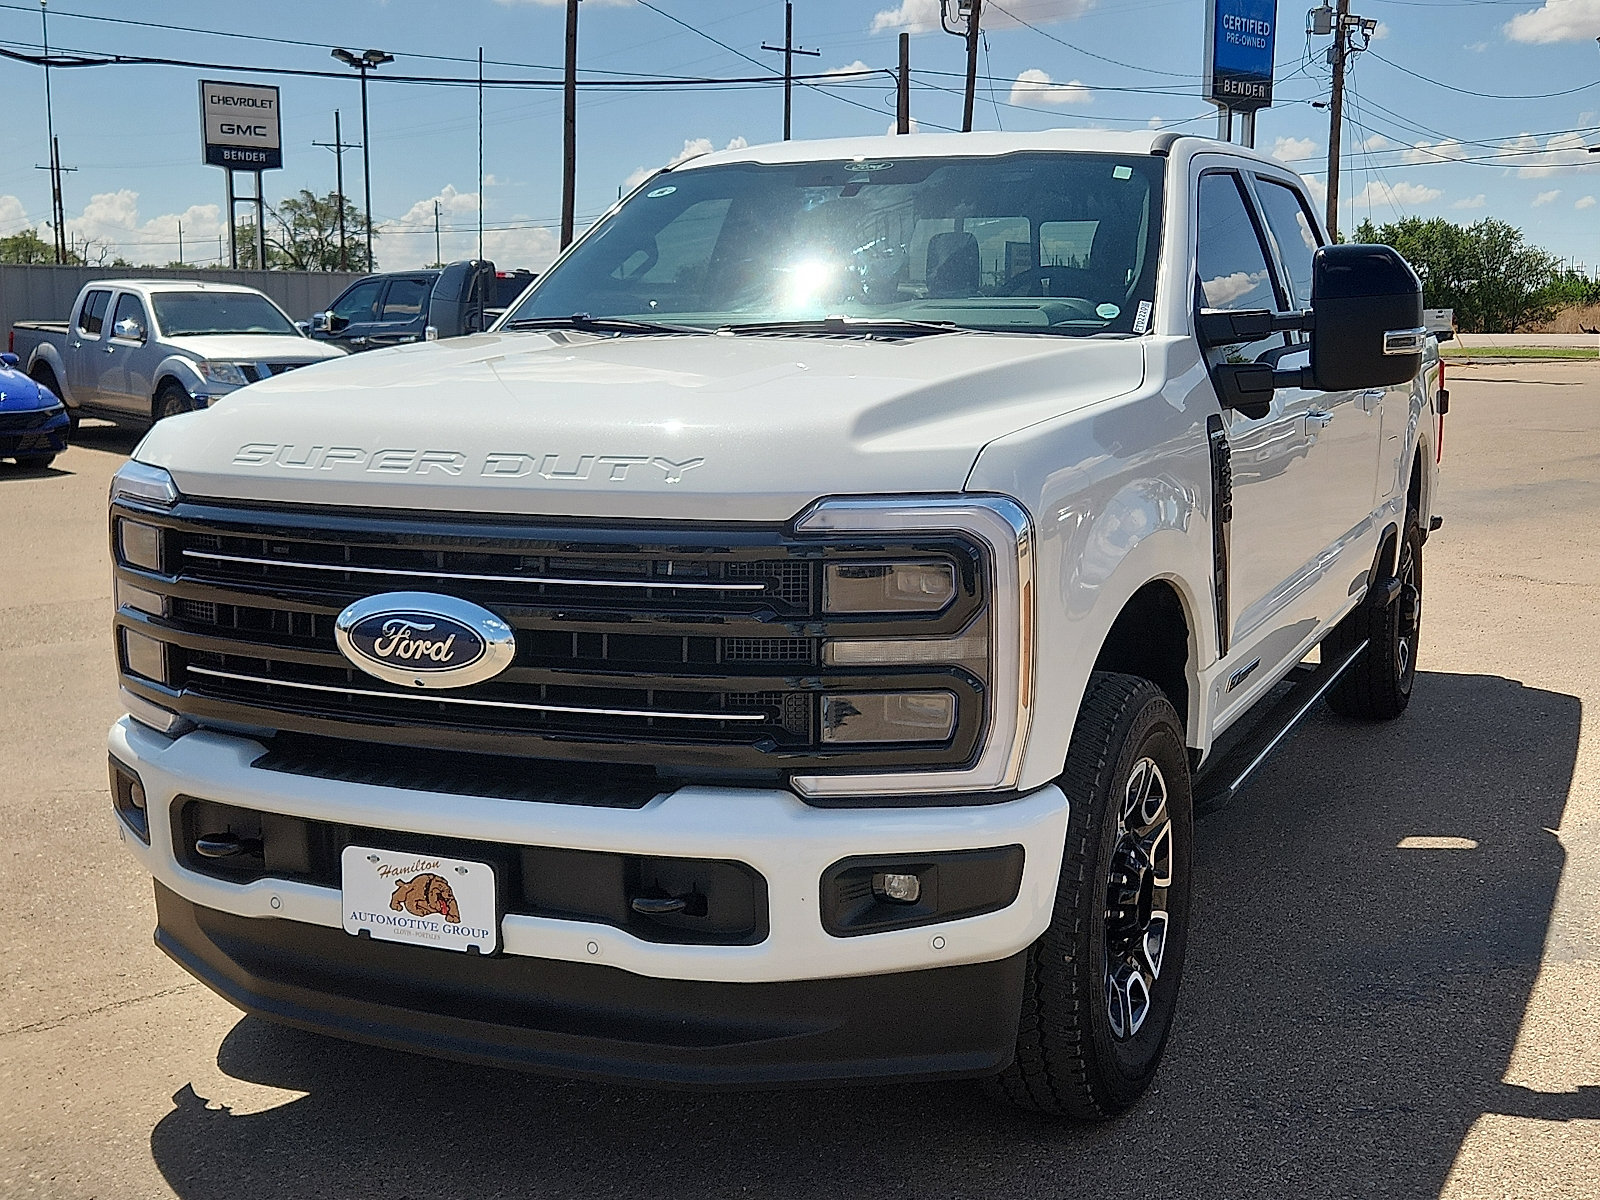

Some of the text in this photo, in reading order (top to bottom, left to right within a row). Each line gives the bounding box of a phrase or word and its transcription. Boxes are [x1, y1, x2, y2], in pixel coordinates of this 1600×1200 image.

[1223, 14, 1270, 36] CERTIFIED
[1226, 32, 1266, 48] PRE-OWNED
[1224, 80, 1265, 97] BENDER
[210, 95, 273, 108] CHEVROLET
[220, 123, 267, 136] GMC
[223, 150, 266, 162] BENDER
[232, 443, 706, 484] SUPER DUTY
[374, 618, 457, 663] Ford
[376, 859, 442, 879] Hamilton
[350, 911, 489, 938] AUTOMOTIVE GROUP
